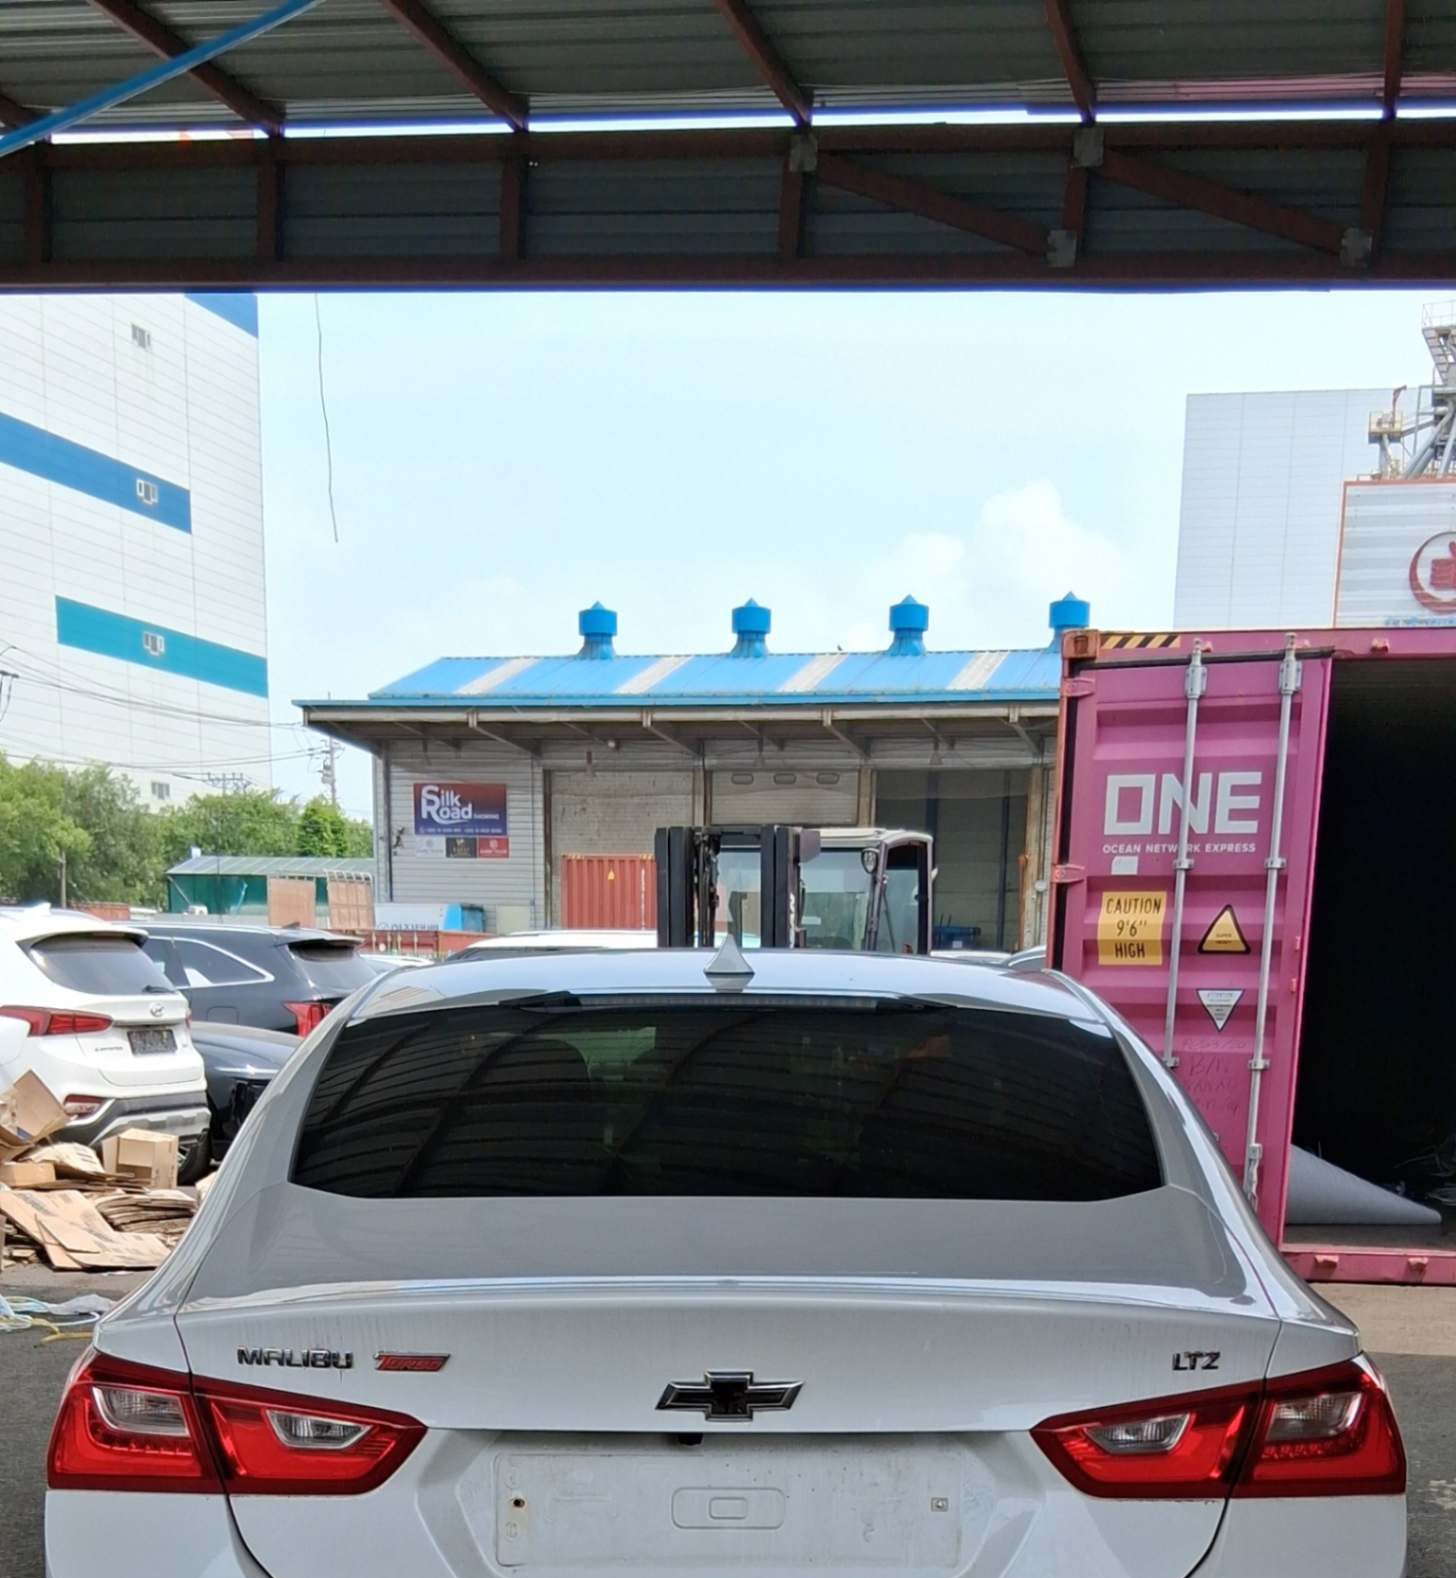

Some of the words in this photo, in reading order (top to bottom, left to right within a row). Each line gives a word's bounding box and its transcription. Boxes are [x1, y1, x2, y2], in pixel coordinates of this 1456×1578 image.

[421, 785, 462, 806] Silk
[1103, 771, 1262, 836] ONE
[421, 798, 473, 825] Road
[1102, 843, 1141, 854] OCEAN
[1145, 843, 1201, 854] NETWRK
[1204, 842, 1257, 854] EXPRESS
[1105, 897, 1162, 914] CAUTION
[1114, 942, 1146, 959] HIGH
[236, 1346, 354, 1370] MALIBU
[1171, 1350, 1221, 1371] LTZ
